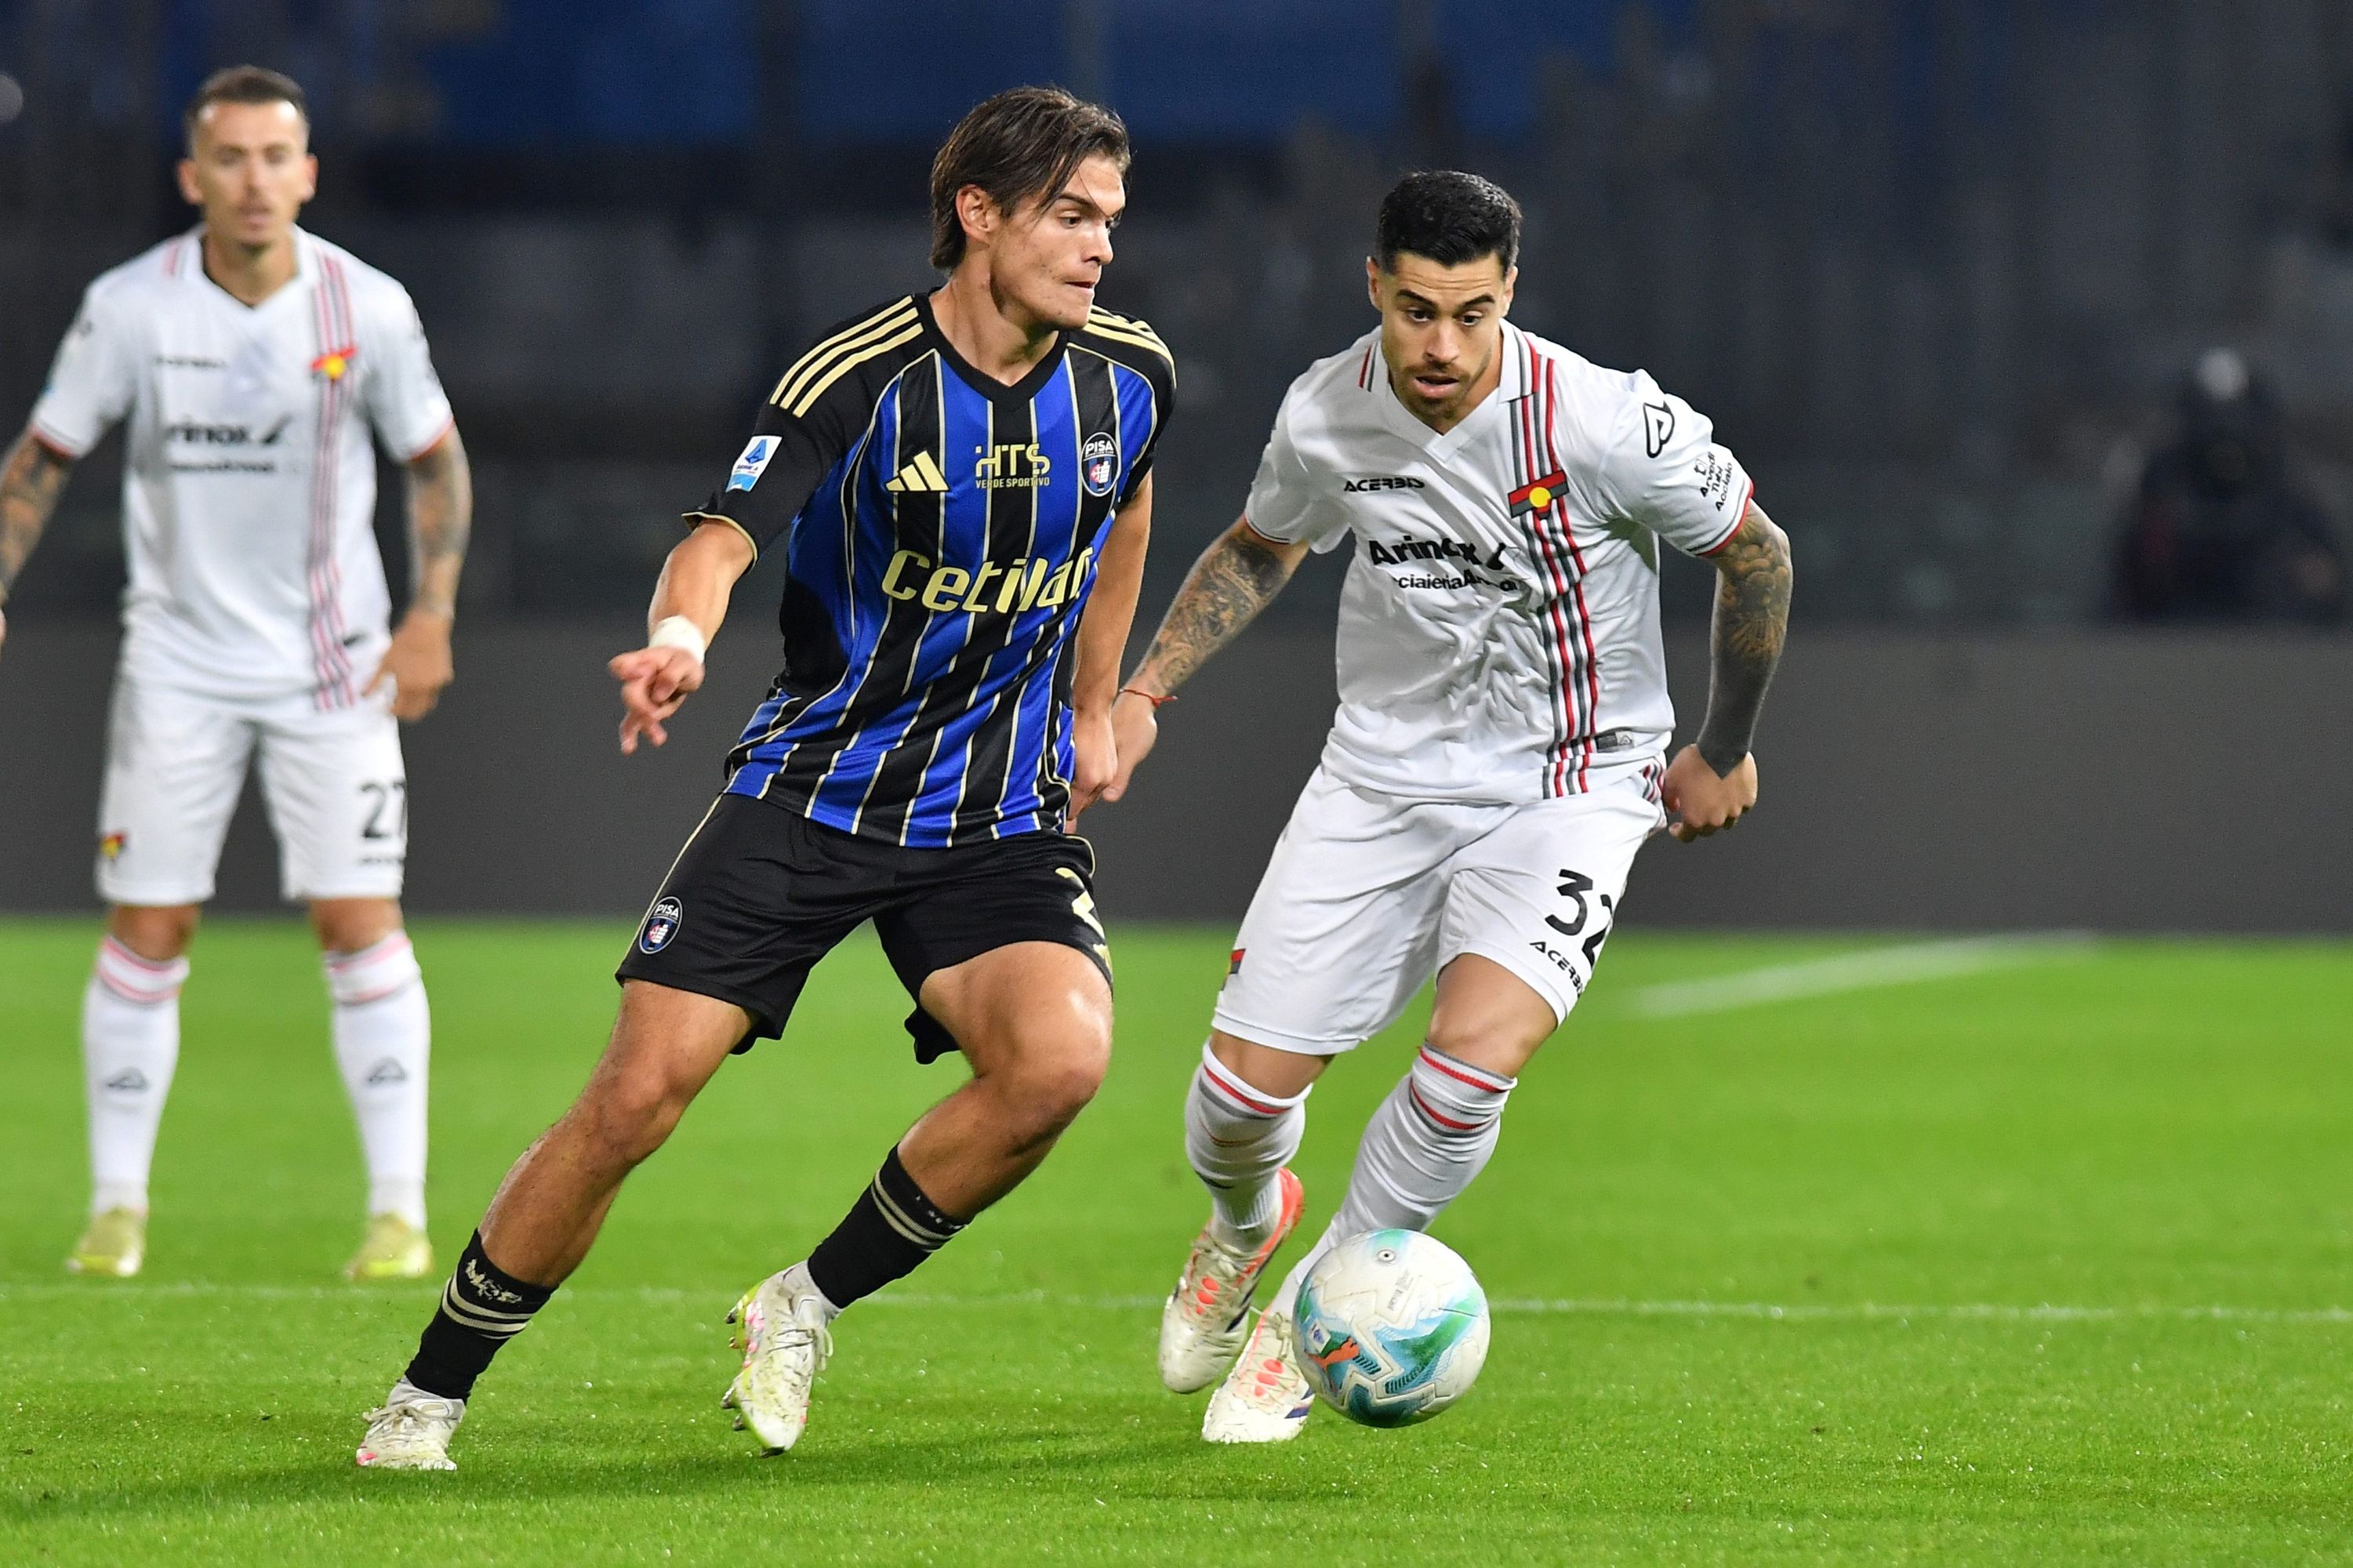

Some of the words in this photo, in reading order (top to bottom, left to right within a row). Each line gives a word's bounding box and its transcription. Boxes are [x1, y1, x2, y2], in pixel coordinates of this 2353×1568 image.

[1085, 440, 1113, 459] PISA
[975, 478, 1004, 488] VERDE
[1006, 477, 1051, 488] SPORTIVO
[881, 546, 1094, 614] Cetilar
[654, 904, 679, 920] PISA
